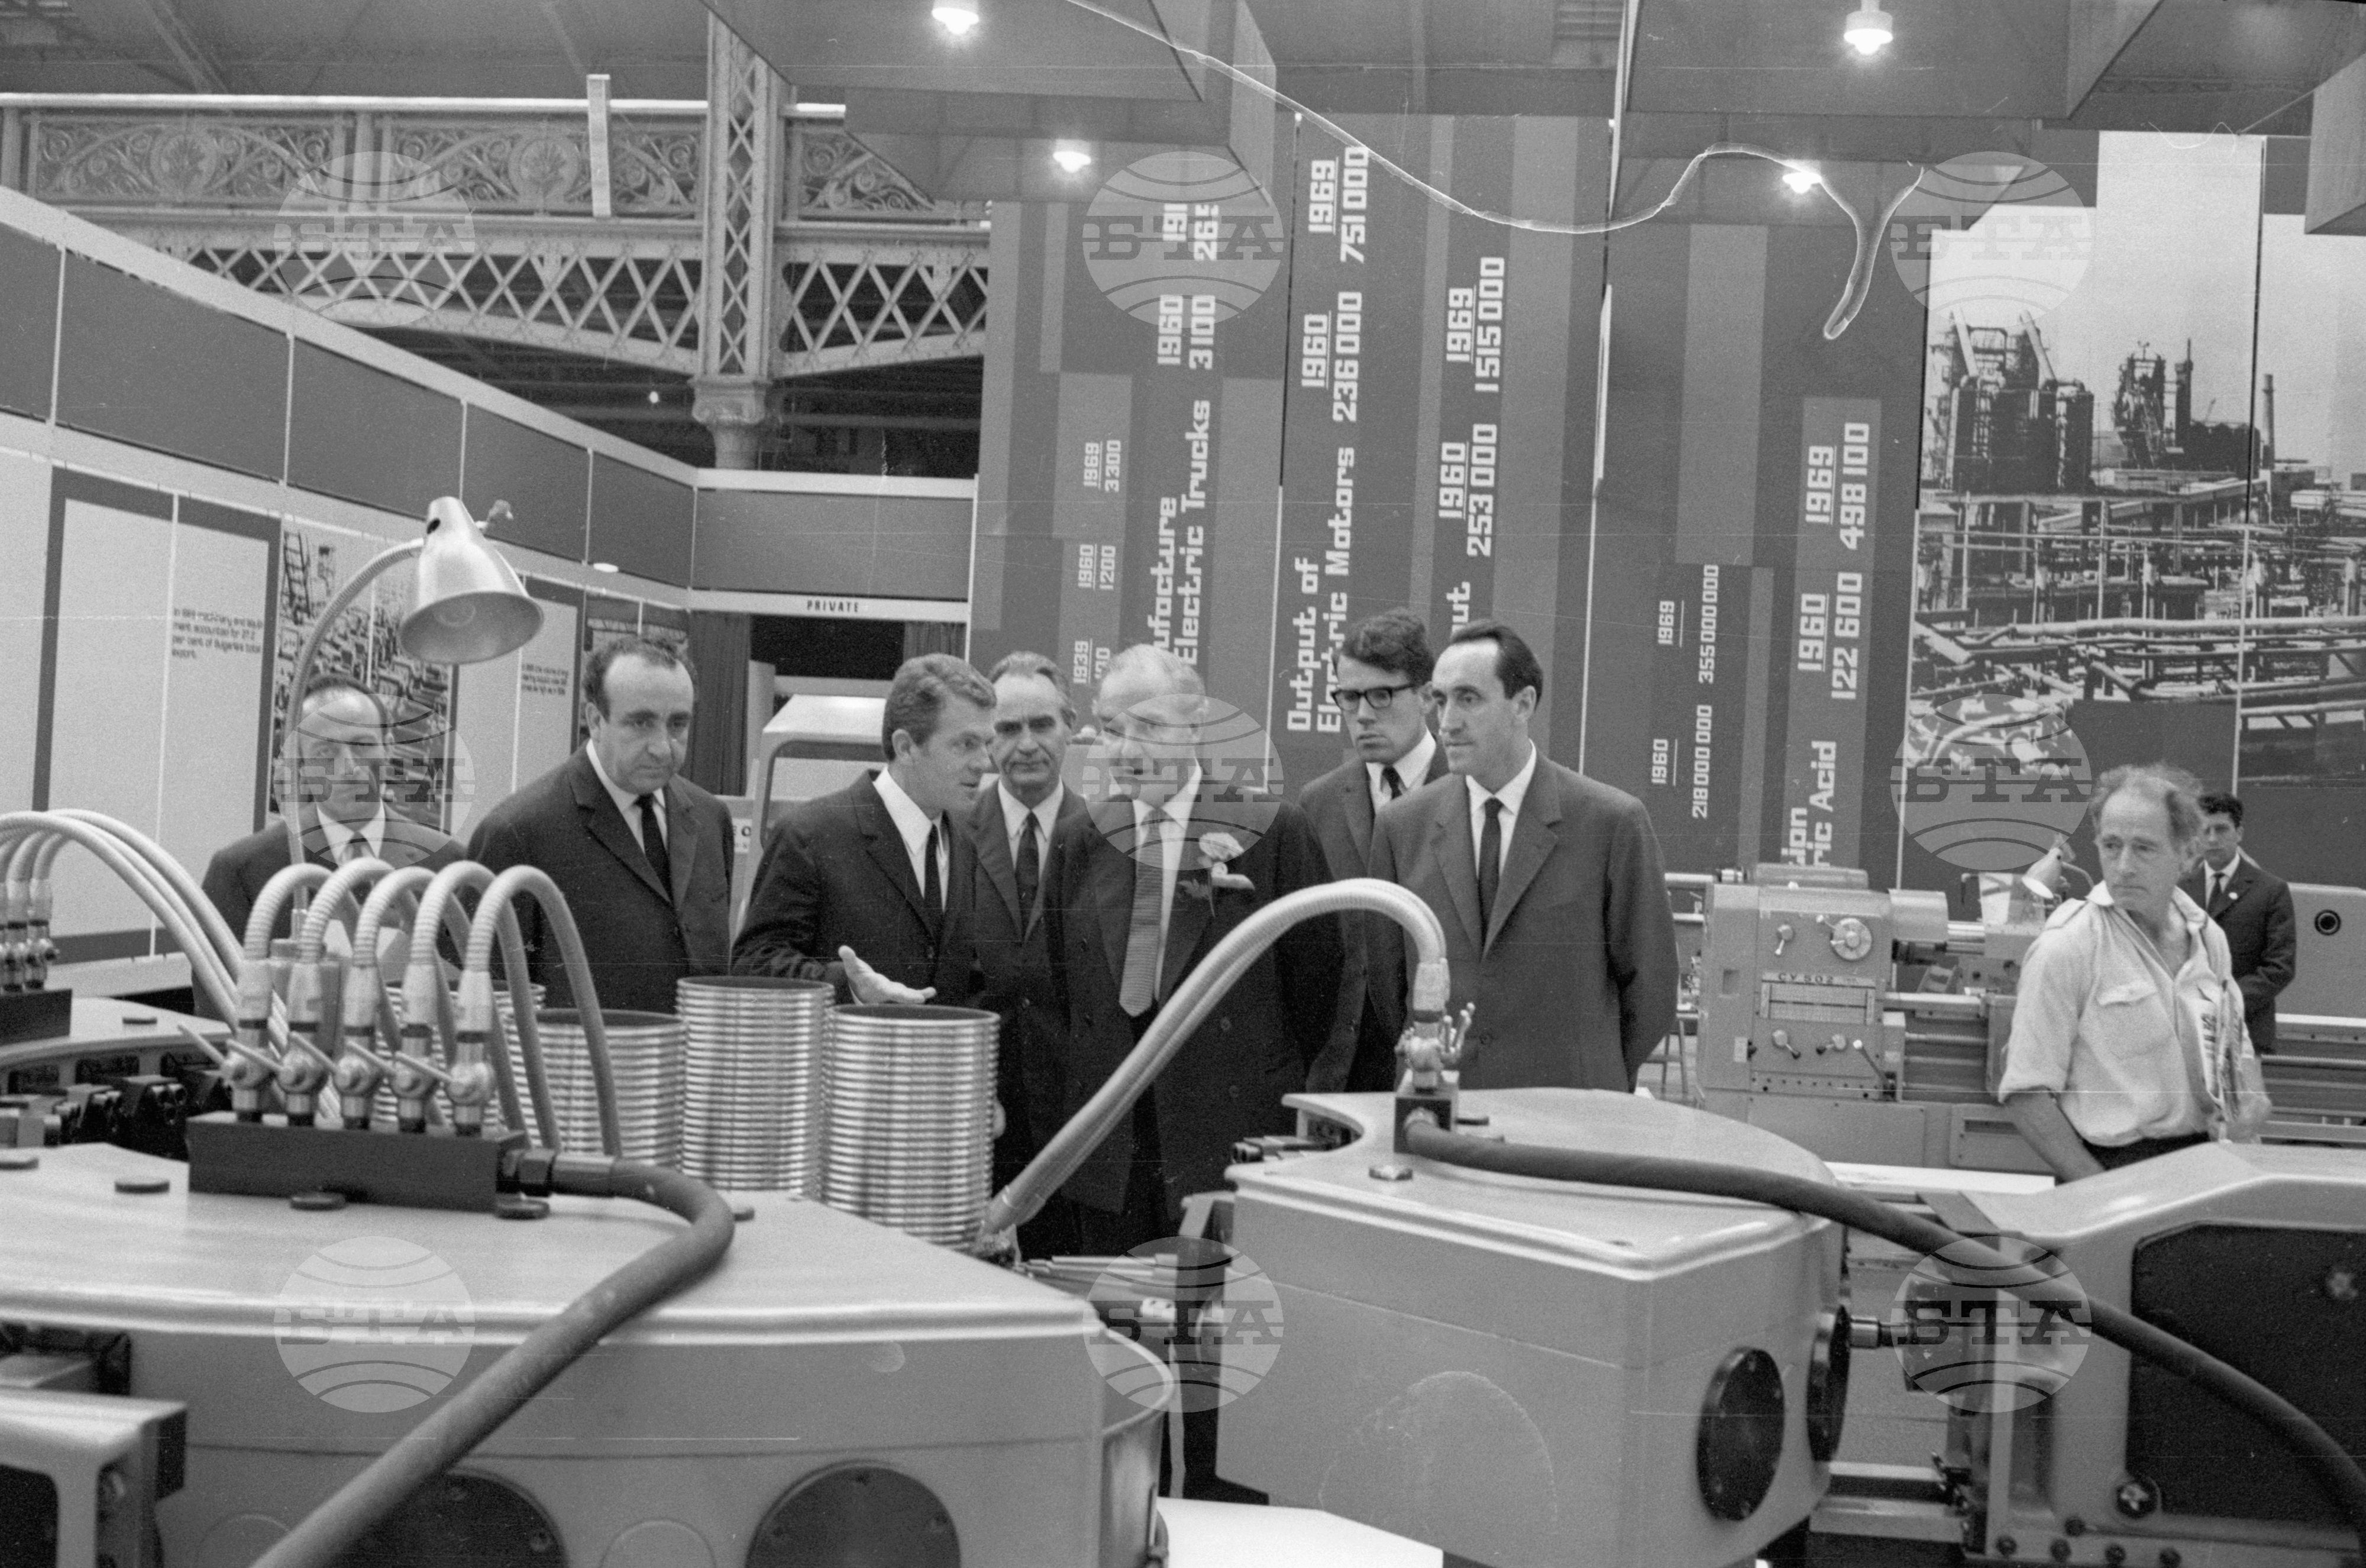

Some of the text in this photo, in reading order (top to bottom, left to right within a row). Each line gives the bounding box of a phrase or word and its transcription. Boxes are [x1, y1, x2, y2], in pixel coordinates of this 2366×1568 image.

[1308, 160, 1336, 233] 1969
[1157, 294, 1184, 365] 1960
[1301, 313, 1329, 387] 1960
[1446, 287, 1473, 362] 1969
[1083, 441, 1100, 488] 1969
[1439, 442, 1466, 518] 1960
[1805, 445, 1834, 523] 1969
[1174, 400, 1210, 665] Electric Trucks
[1325, 447, 1355, 576] Motors
[1078, 544, 1094, 589] 1960
[1147, 497, 1177, 649] ufacture
[806, 599, 859, 613] PRIVATE
[1658, 601, 1675, 644] 1969
[1798, 593, 1826, 671] 1960
[1287, 557, 1321, 731] Output of
[1651, 739, 1668, 784] 1960
[1809, 741, 1837, 812] Acid
